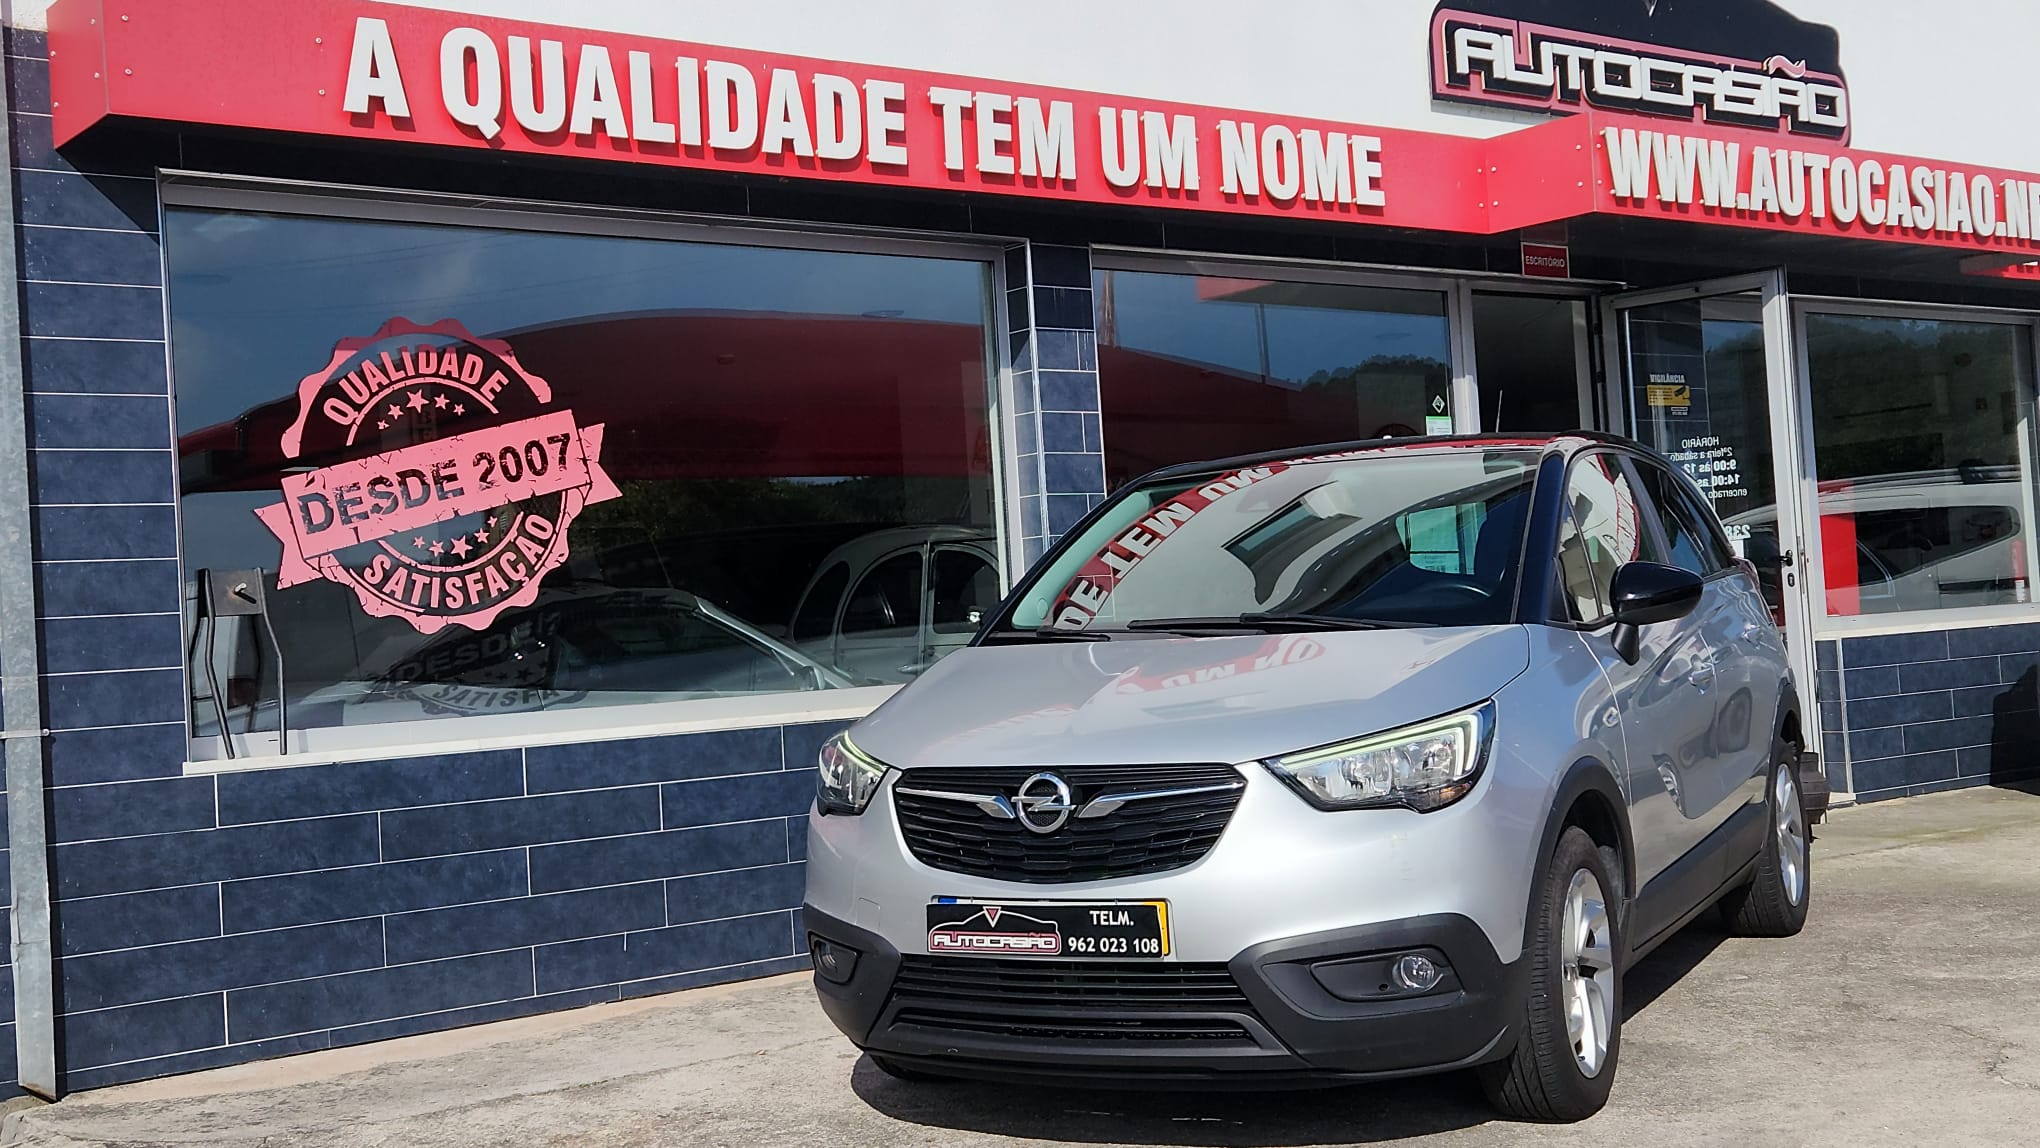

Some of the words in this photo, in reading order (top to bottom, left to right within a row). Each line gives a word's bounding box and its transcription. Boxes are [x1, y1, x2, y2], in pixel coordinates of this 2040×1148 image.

[343, 17, 410, 118] A
[441, 28, 908, 165] QUALIDADE
[929, 87, 1077, 180] TEM
[1099, 107, 1199, 190] UM
[1216, 120, 1386, 207] NOME
[1455, 28, 1847, 127] AUTOCASIÃO
[1525, 255, 1566, 268] ESCRITÓRIO
[323, 345, 509, 426] QUALIDADE
[296, 458, 465, 535] DESDE
[473, 432, 571, 491] 2007
[1068, 937, 1096, 953] 962
[1101, 937, 1127, 953] 023
[1133, 938, 1159, 953] 108
[1089, 910, 1135, 926] TELM.
